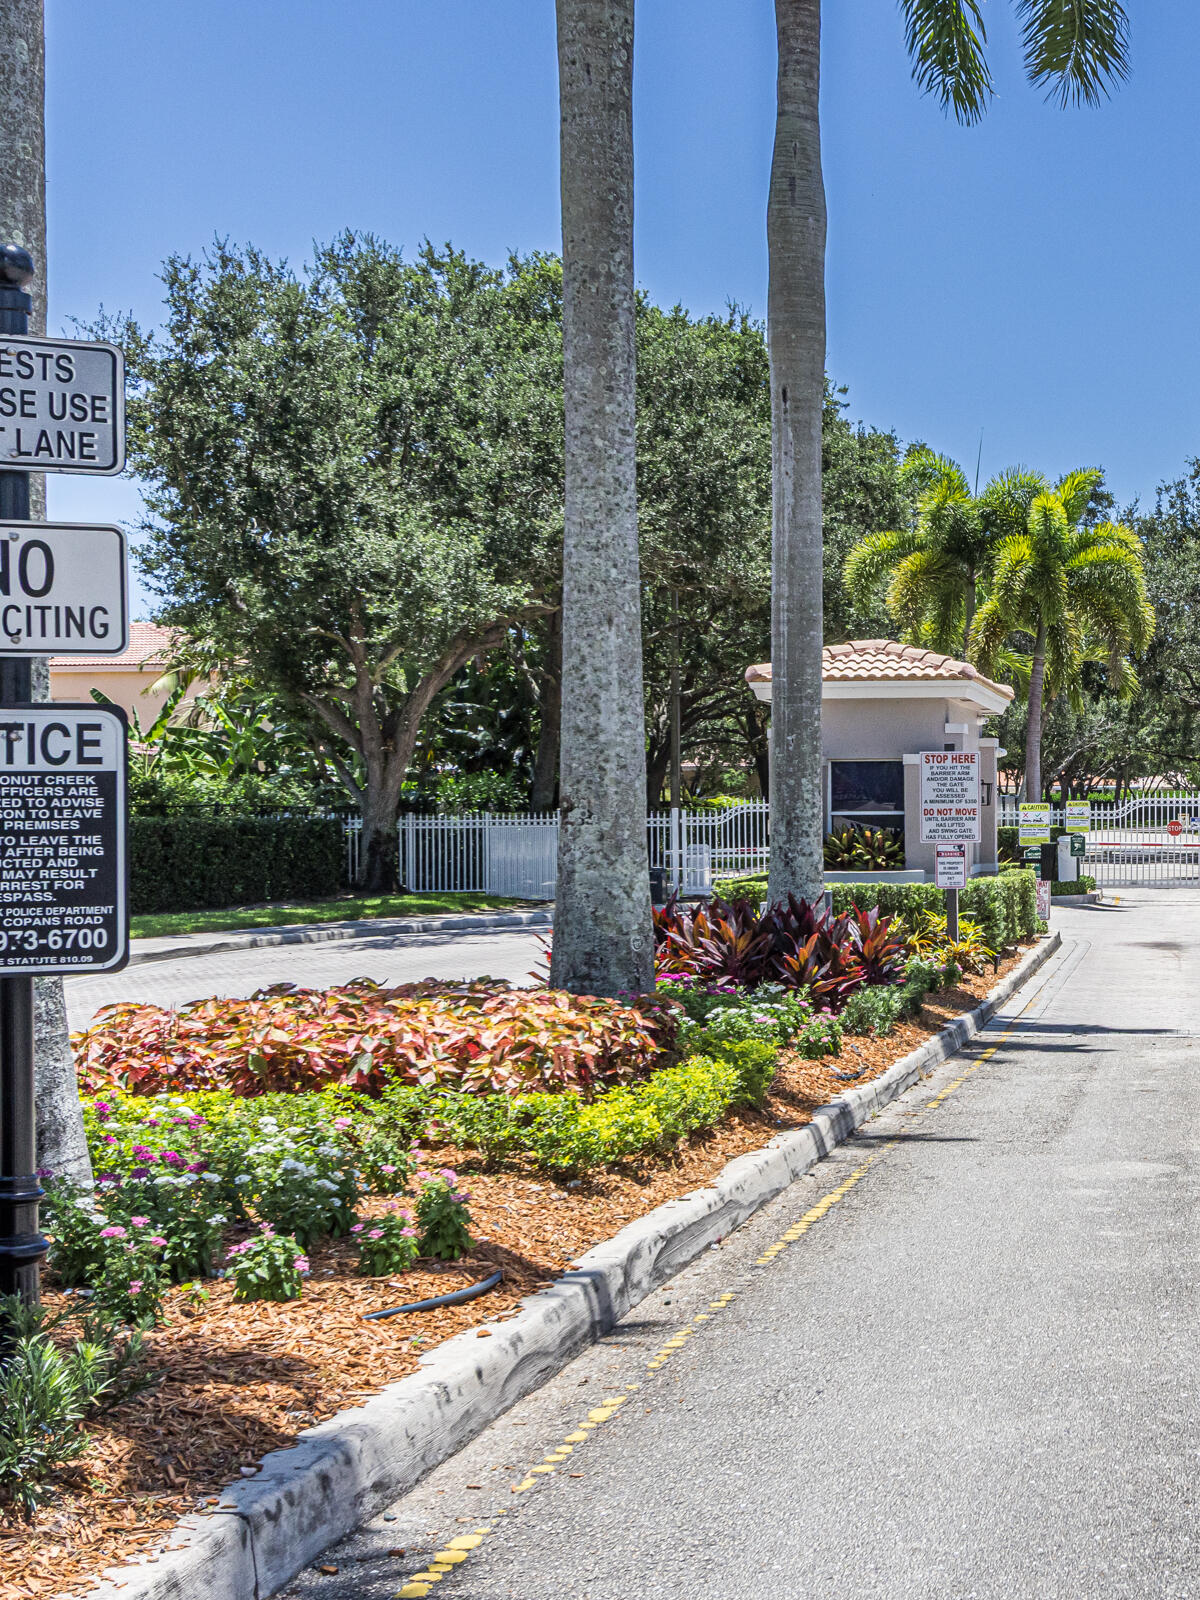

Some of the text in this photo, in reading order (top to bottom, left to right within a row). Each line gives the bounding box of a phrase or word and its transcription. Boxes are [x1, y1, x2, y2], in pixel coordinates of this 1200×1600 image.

[49, 392, 108, 423] USE
[16, 428, 96, 460] LANE
[2, 604, 109, 639] CITING
[924, 755, 976, 764] STOP HERE
[45, 776, 96, 785] CREEK
[68, 787, 98, 796] ARE
[0, 798, 104, 808] ED TO ADVISE
[29, 809, 50, 819] TO
[54, 809, 103, 818] LEAVE
[4, 820, 80, 830] PREMISES
[20, 836, 69, 845] LEAVE
[72, 835, 102, 844] THE
[5, 847, 104, 856] AFTER BEING
[47, 858, 78, 867] AND
[2, 869, 98, 879] MAY RESULT
[54, 880, 84, 890] FOR
[6, 908, 43, 916] POLICE
[46, 906, 114, 915] DEPARTMENT
[3, 916, 103, 926] COPANS ROAD
[7, 956, 56, 965] STATUTE
